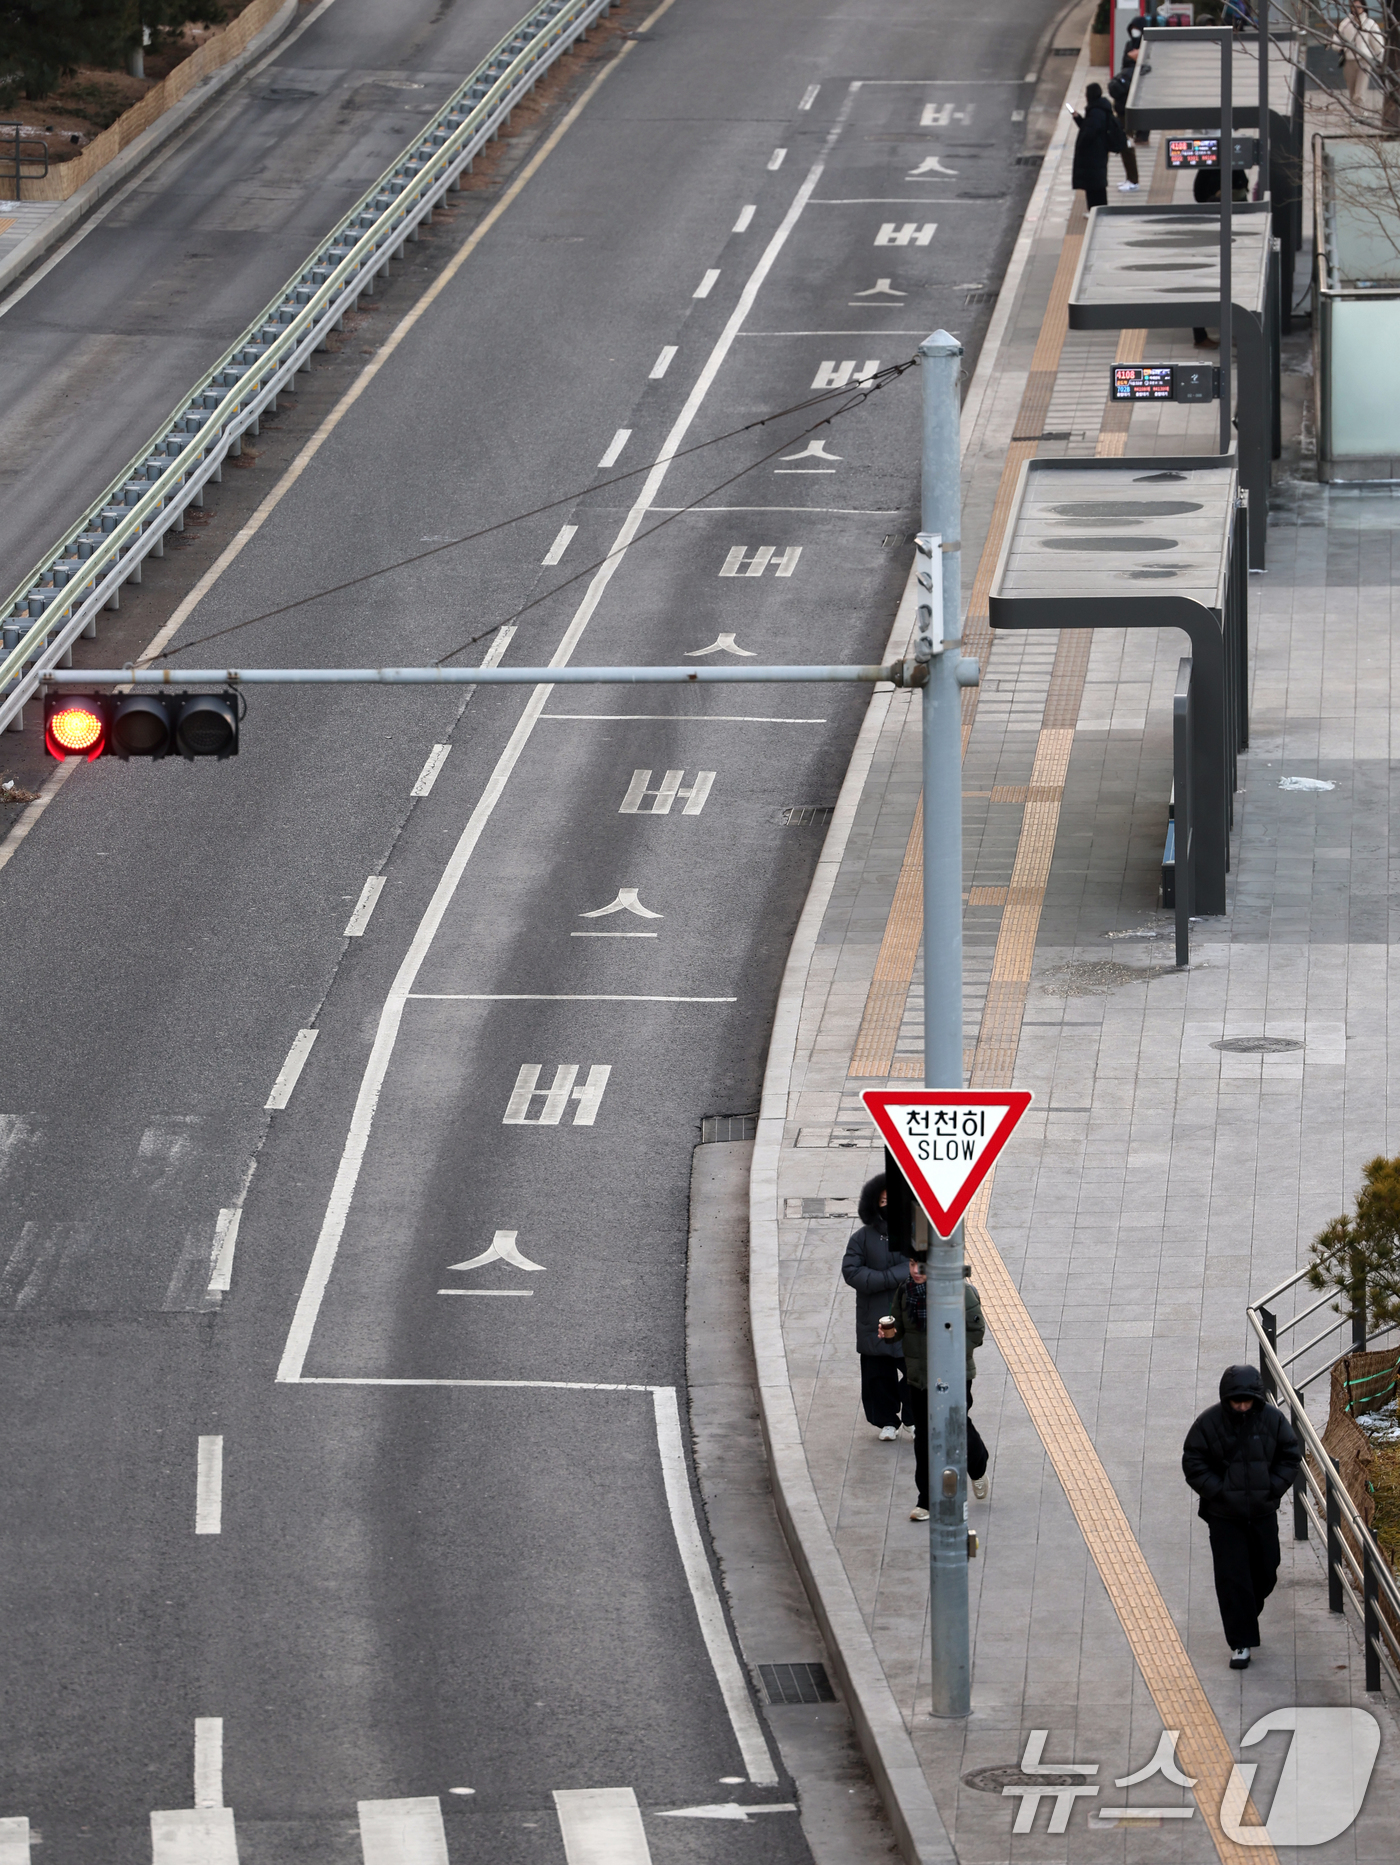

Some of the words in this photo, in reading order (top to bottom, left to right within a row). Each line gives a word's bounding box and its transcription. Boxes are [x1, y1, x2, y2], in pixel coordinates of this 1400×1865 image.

[848, 223, 938, 306] 버스
[1116, 370, 1135, 379] 4108
[774, 360, 880, 473] 버스
[570, 769, 717, 936] 버스
[906, 1110, 985, 1137] 천천히
[918, 1140, 976, 1161] SLOW
[437, 1064, 612, 1295] 버스
